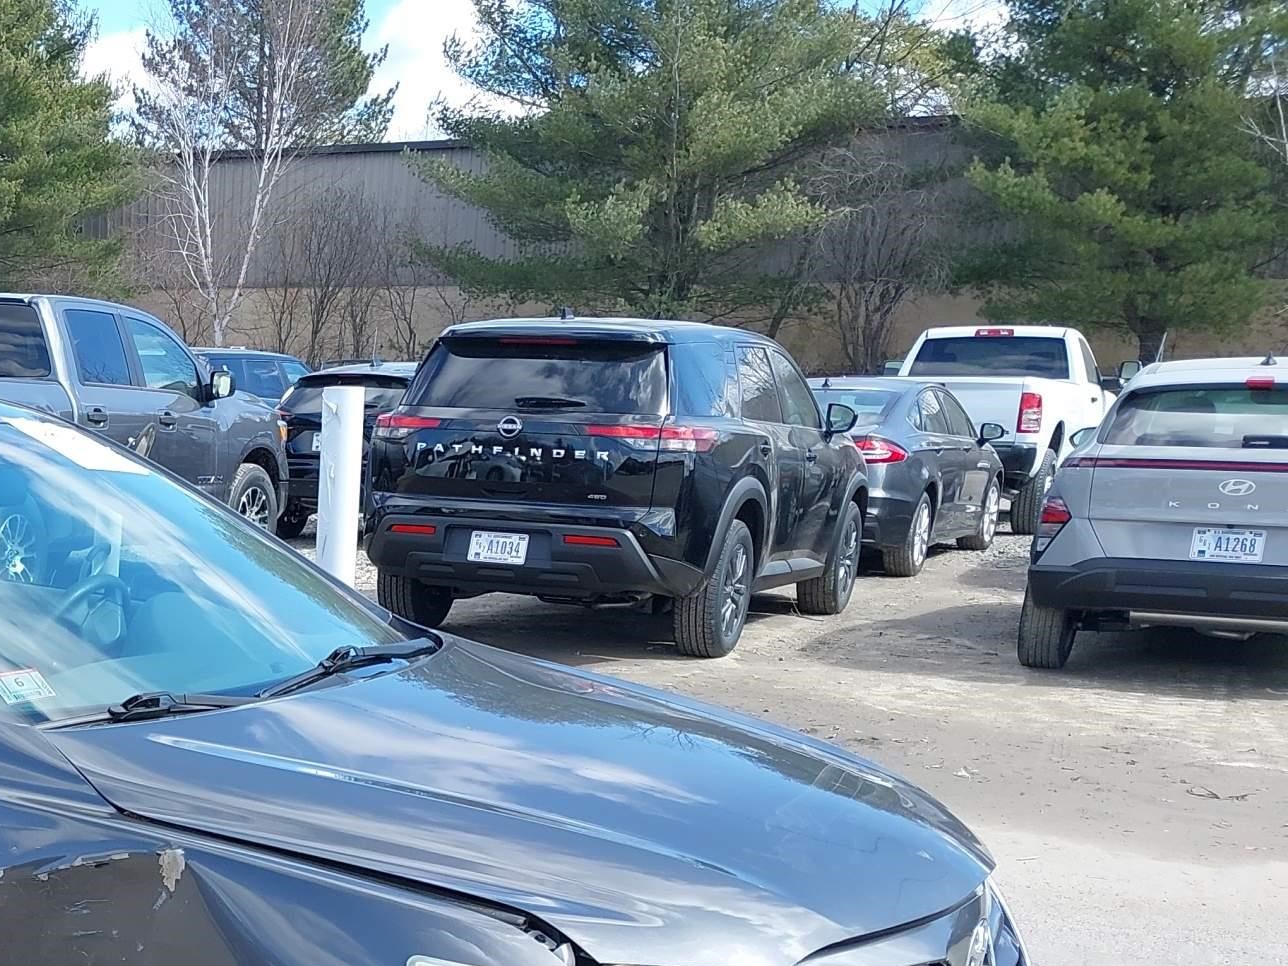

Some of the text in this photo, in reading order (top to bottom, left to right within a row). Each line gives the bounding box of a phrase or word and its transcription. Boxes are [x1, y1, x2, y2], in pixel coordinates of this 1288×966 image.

[416, 442, 610, 461] PATHFINDER
[486, 539, 522, 556] A1034
[1214, 536, 1258, 553] A1268
